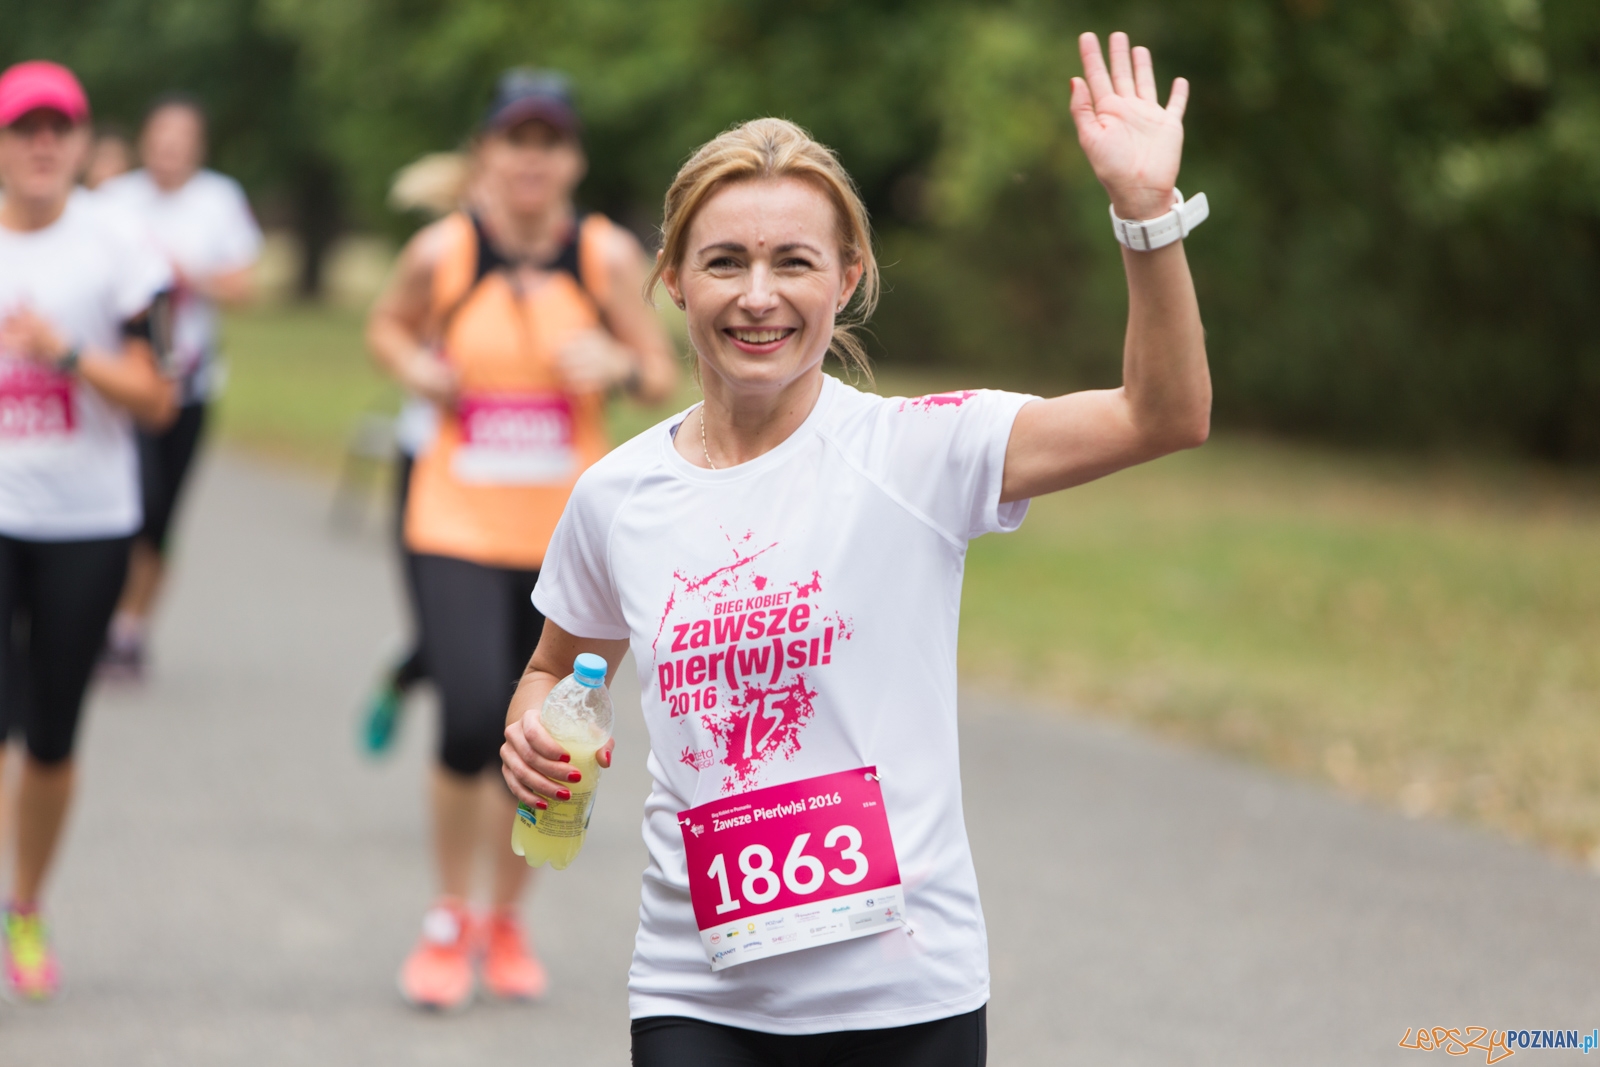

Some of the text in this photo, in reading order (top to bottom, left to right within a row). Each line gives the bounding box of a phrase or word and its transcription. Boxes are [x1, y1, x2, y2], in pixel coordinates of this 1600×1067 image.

[713, 591, 792, 616] BIEG KOBIET
[670, 603, 811, 653] zawsze
[668, 686, 718, 718] 2016
[741, 690, 790, 758] 15
[712, 813, 752, 832] Zawsze
[753, 800, 806, 822] Pier(w)si
[808, 792, 842, 810] 2016
[707, 825, 869, 915] 1863
